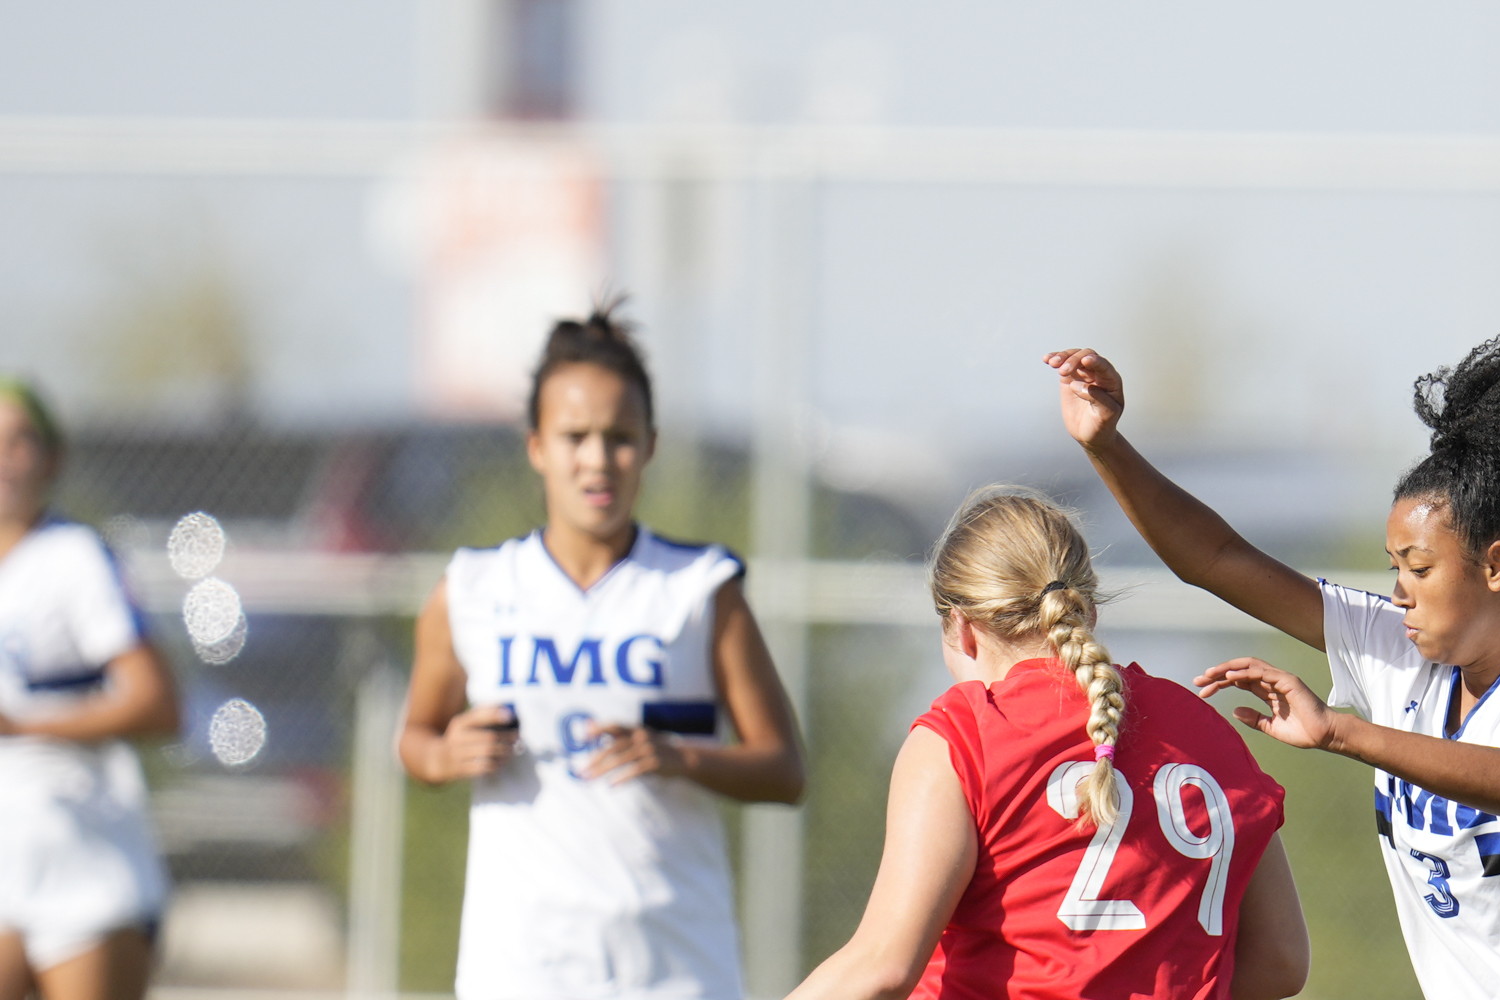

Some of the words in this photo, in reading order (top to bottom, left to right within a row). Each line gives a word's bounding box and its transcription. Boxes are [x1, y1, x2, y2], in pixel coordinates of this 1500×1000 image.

[497, 634, 665, 688] IMG
[1046, 760, 1235, 936] 29
[1410, 848, 1460, 919] 3
